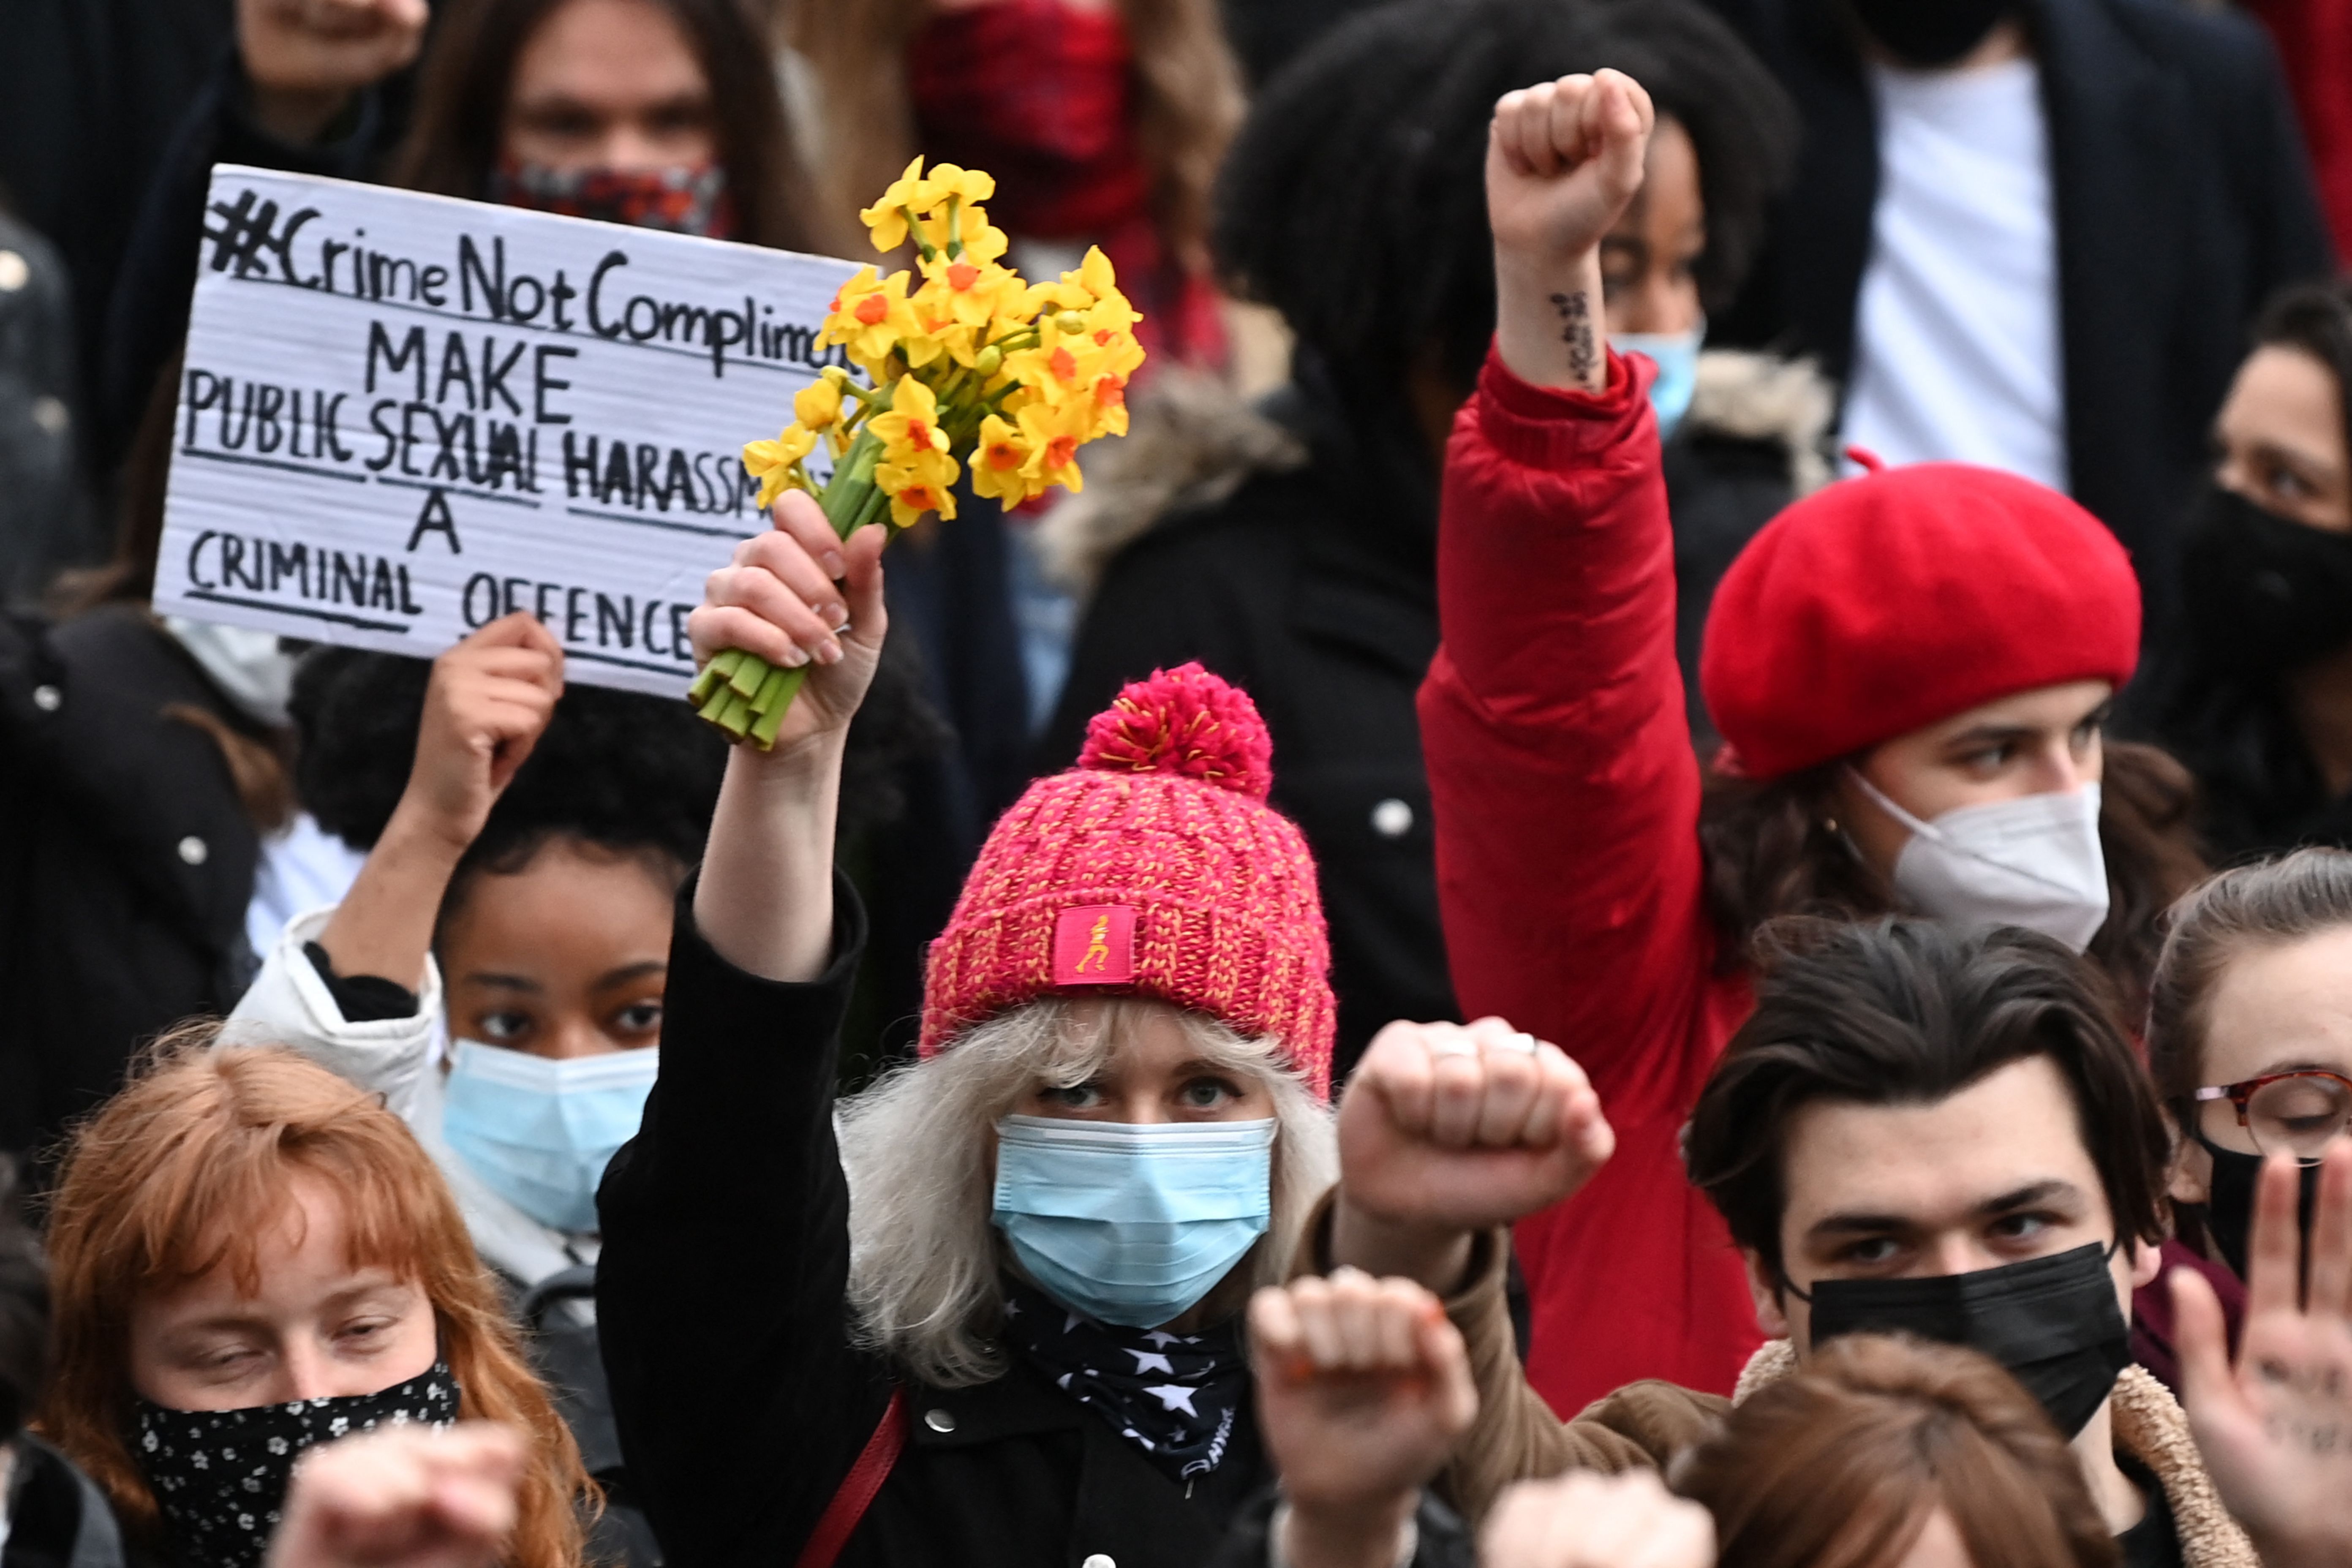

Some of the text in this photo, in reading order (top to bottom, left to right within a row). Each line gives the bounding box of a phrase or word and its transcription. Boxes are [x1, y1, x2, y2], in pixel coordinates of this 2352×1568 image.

[366, 320, 579, 424] MAKE
[186, 369, 833, 521] PUBLIC SEXUAL HARASSM
[406, 487, 462, 555] A
[188, 530, 697, 661] CRIMINAL OFFENCE
